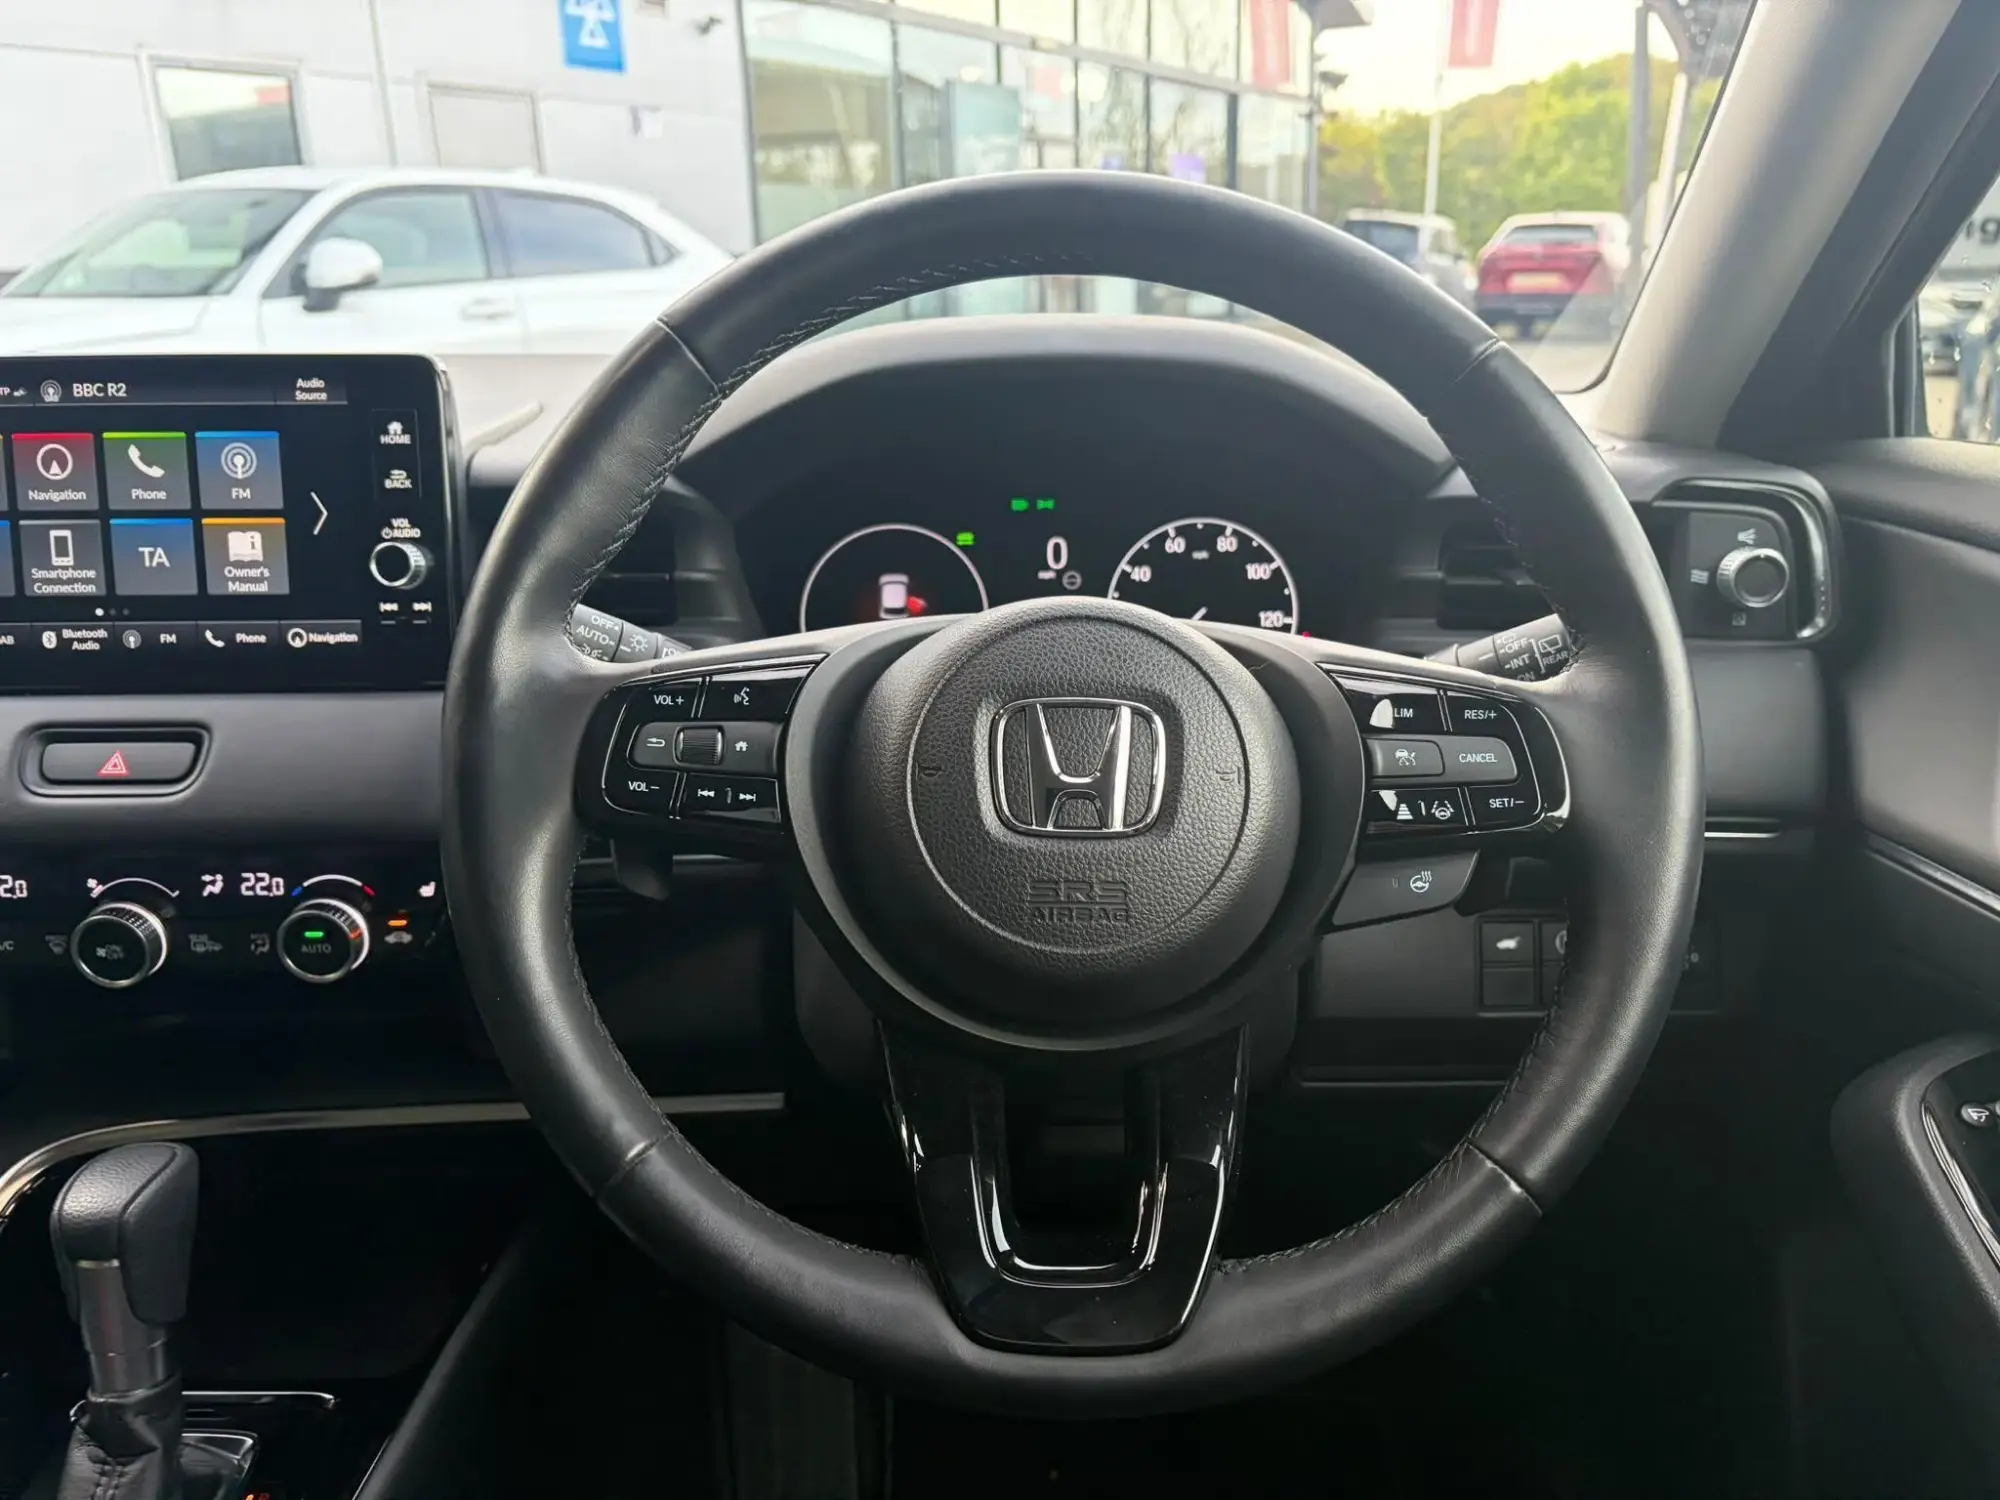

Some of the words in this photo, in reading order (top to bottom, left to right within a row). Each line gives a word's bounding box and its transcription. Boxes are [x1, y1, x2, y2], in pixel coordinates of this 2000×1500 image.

[296, 378, 325, 388] Audio
[72, 383, 105, 397] BBC
[107, 382, 127, 397] R2
[295, 390, 328, 401] Source
[380, 434, 411, 444] HOME
[384, 478, 412, 488] BACK
[28, 489, 87, 502] Navigation
[131, 488, 167, 500] Phone
[231, 488, 251, 499] FM
[391, 518, 411, 527] VOL
[393, 528, 421, 538] AUDIO
[1165, 537, 1186, 553] 60
[1216, 536, 1238, 552] 80
[138, 547, 170, 567] TA
[1046, 536, 1068, 570] 0
[31, 568, 97, 580] Smartphone
[224, 566, 270, 578] Owner's
[1131, 565, 1152, 582] 40
[1245, 563, 1272, 580] 100
[33, 581, 96, 594] Connection
[228, 581, 268, 592] Manual
[591, 615, 614, 629] OFF
[1259, 611, 1284, 627] 120
[62, 628, 108, 639] Bluetooth
[160, 633, 177, 644] FM
[236, 632, 267, 643] Phone
[309, 632, 358, 645] Navigation
[577, 624, 609, 645] AUTO
[72, 641, 100, 650] Audio
[1505, 637, 1529, 653] OFF
[1510, 653, 1530, 670] INT
[1542, 650, 1568, 666] REAR
[1394, 707, 1413, 718] LIM
[1459, 753, 1498, 763] CANCEL
[240, 872, 285, 897] 22.0
[1030, 880, 1127, 901] SRS
[301, 943, 332, 954] AUTO
